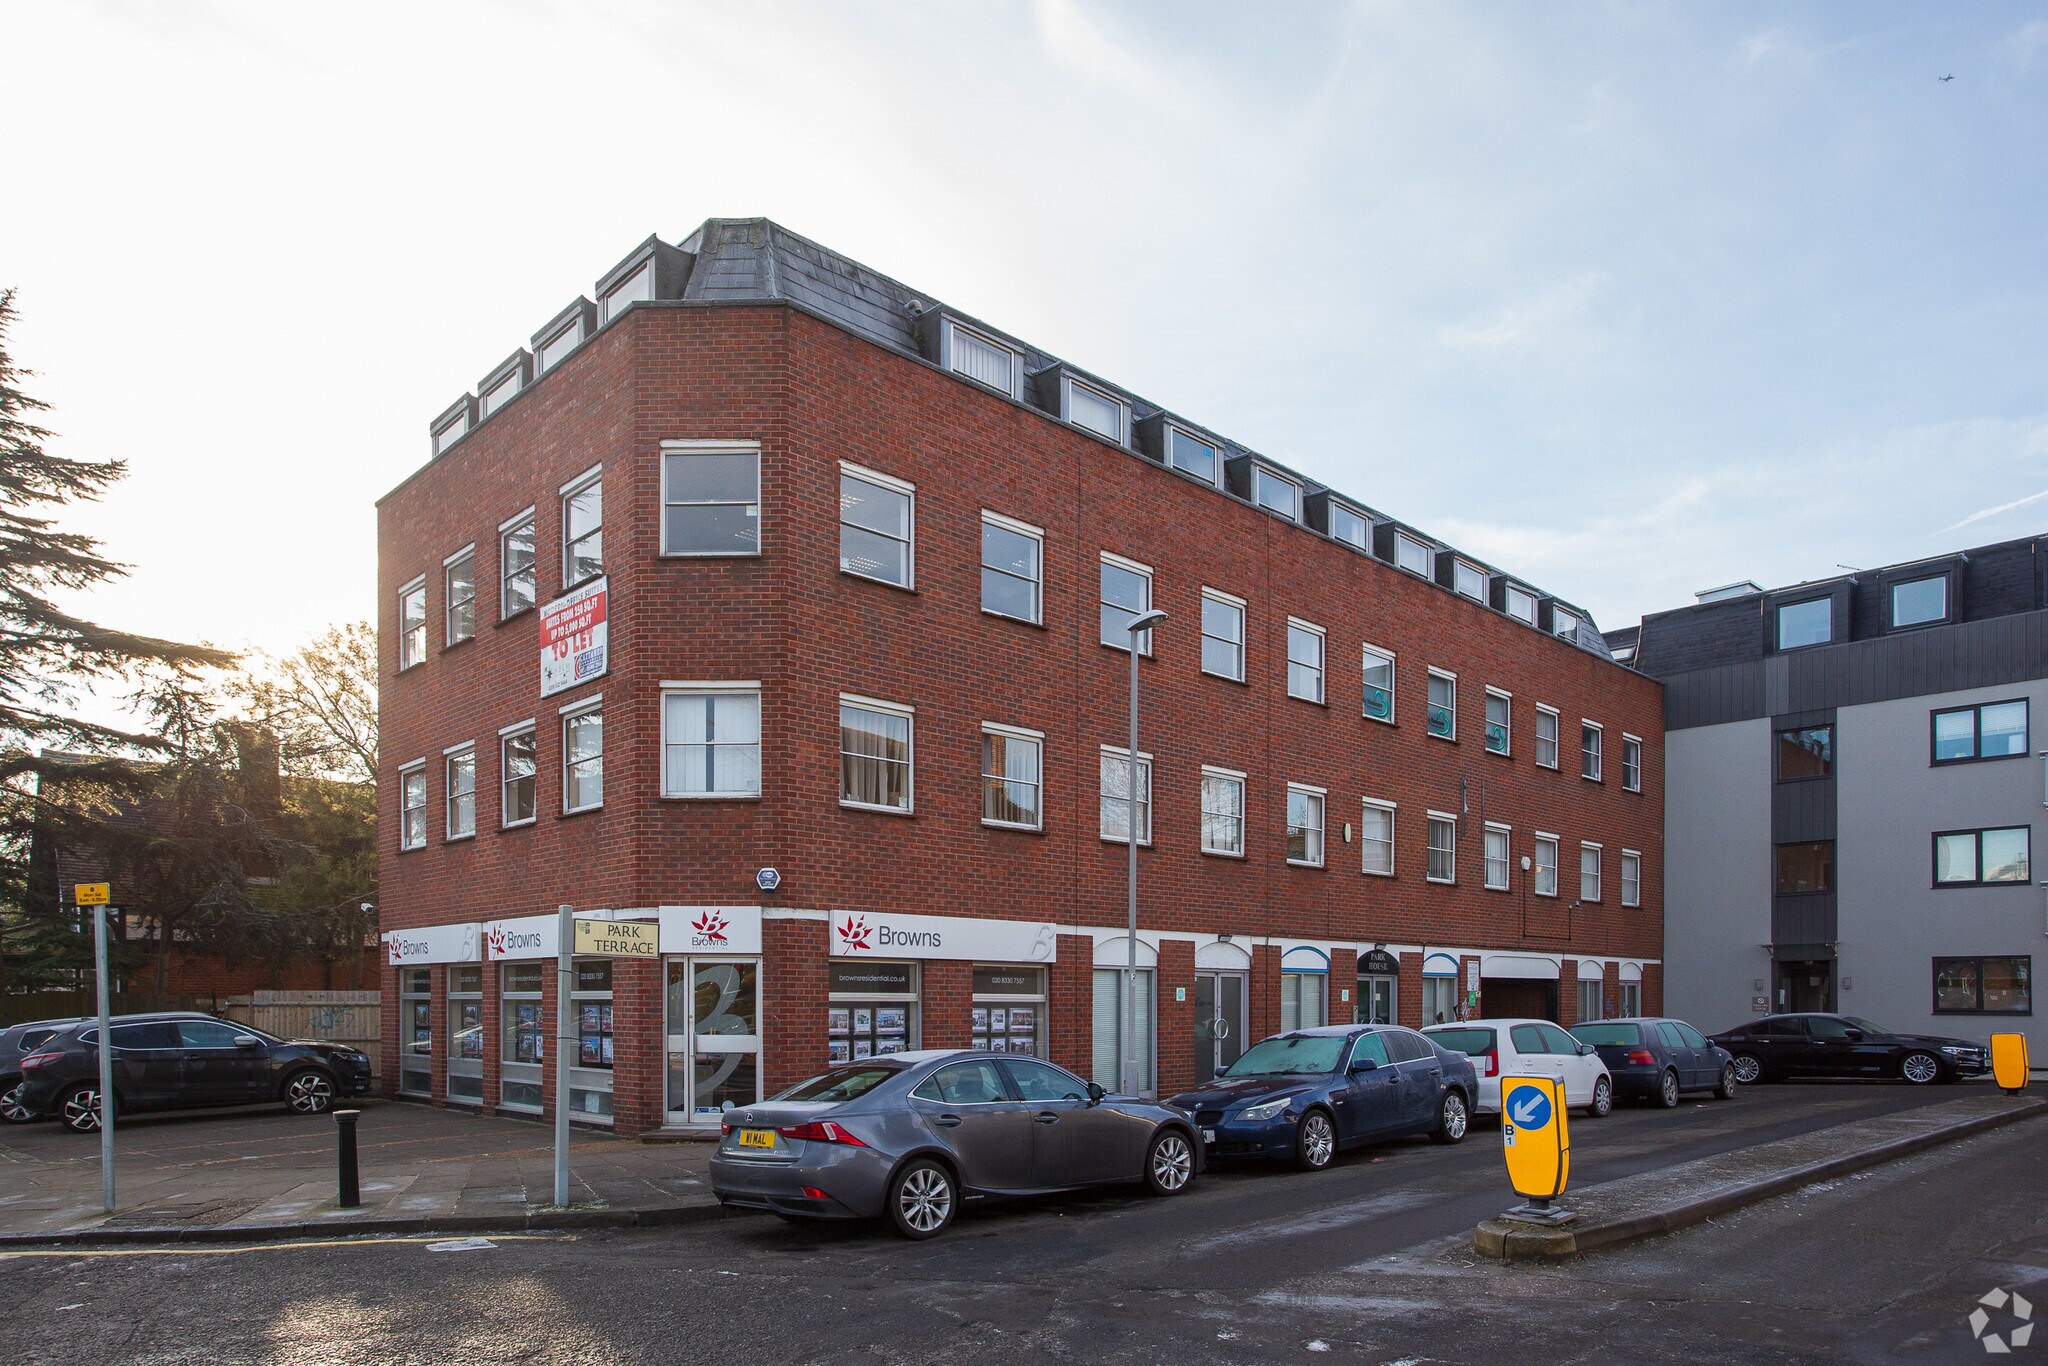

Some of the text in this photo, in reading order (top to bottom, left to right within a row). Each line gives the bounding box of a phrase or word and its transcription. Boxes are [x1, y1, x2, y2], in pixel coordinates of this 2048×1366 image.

[584, 583, 604, 598] SUITES
[551, 627, 593, 662] TO LET
[607, 924, 641, 939] PARK
[878, 925, 942, 948] Browns
[507, 931, 541, 949] Browns
[593, 939, 654, 954] TERRACE
[691, 936, 729, 947] Browns
[403, 939, 429, 956] Browns
[1370, 953, 1386, 961] PARK
[1368, 962, 1388, 971] HOUSE
[838, 974, 906, 983] brownsresidential.co.uk
[991, 976, 1001, 984] 020
[1505, 1124, 1515, 1136] B
[1506, 1137, 1512, 1146] 1
